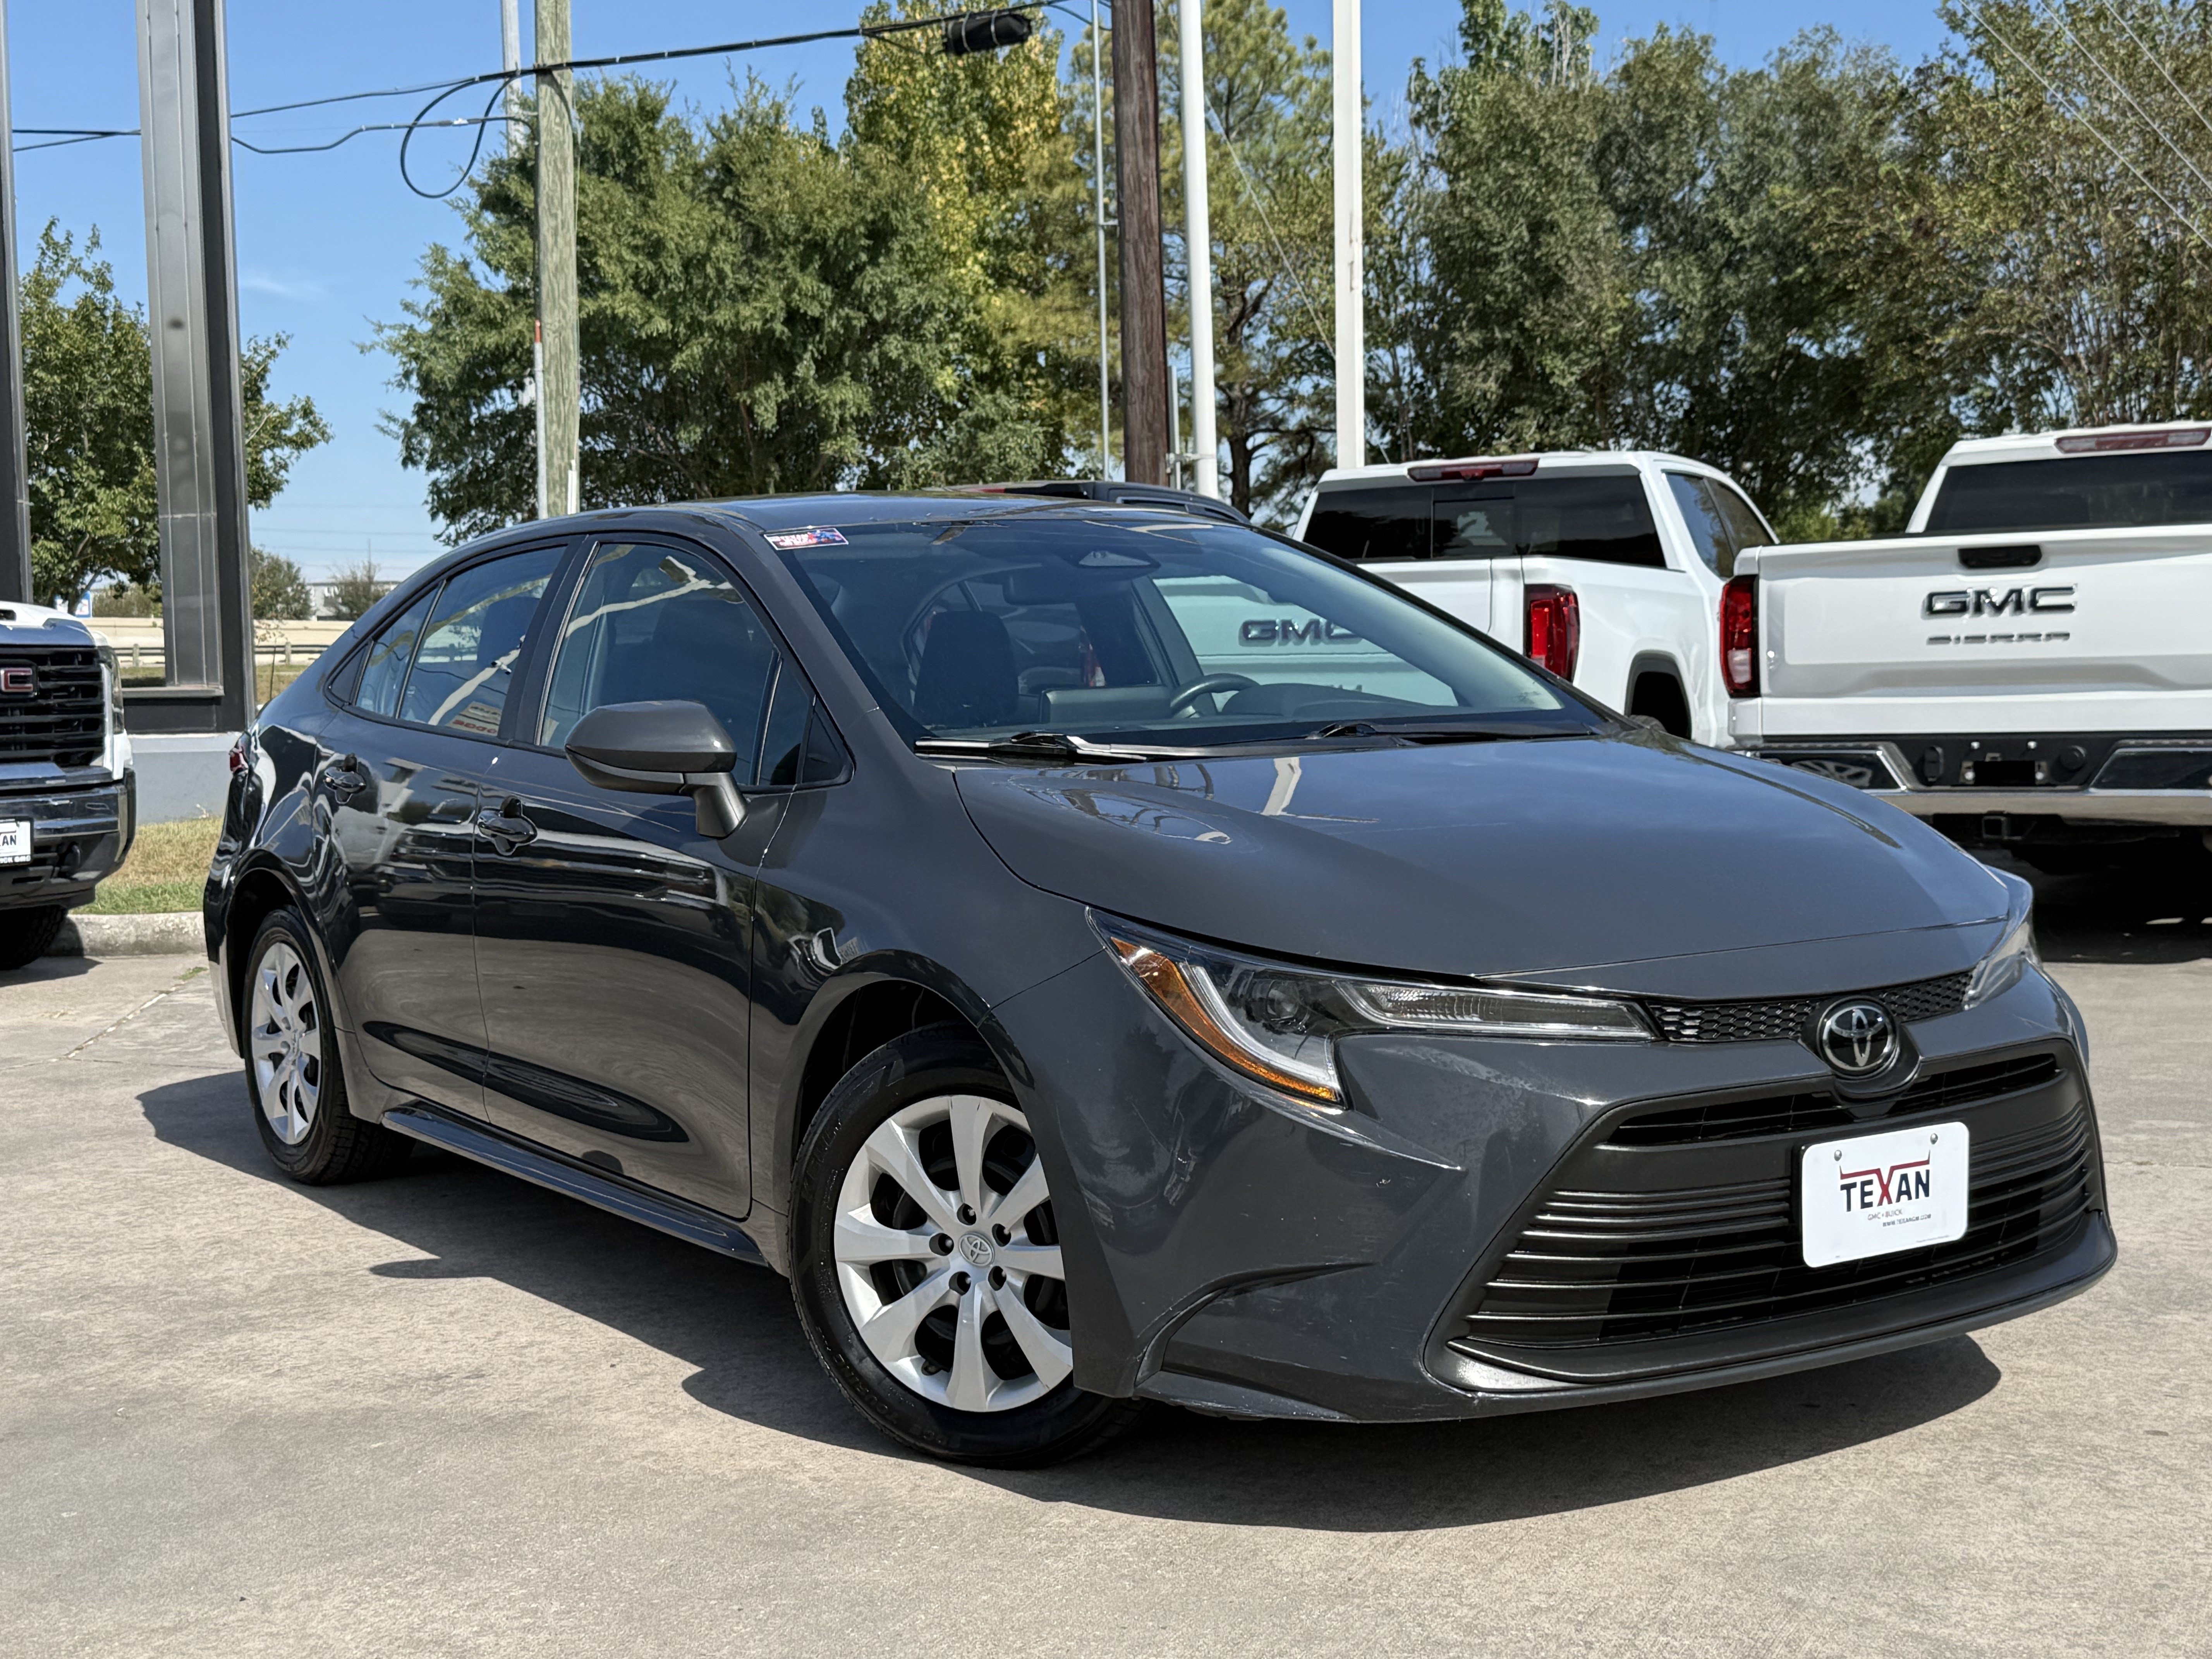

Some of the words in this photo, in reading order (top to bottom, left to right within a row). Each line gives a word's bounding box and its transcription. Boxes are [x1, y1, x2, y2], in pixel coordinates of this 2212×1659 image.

[1925, 583, 2077, 617] GMC
[0, 833, 16, 846] AN
[1840, 1165, 1930, 1212] TEXAN
